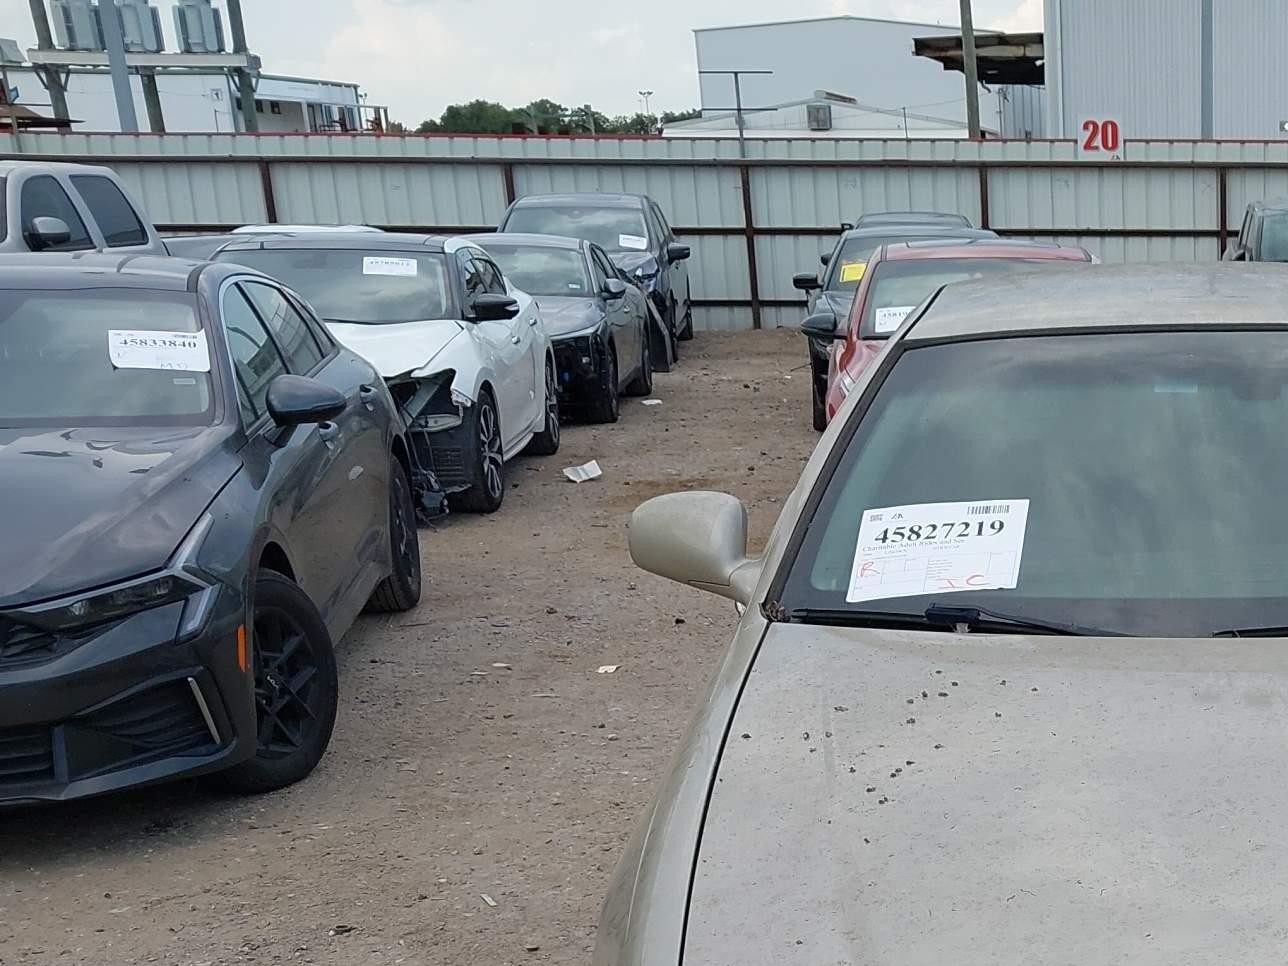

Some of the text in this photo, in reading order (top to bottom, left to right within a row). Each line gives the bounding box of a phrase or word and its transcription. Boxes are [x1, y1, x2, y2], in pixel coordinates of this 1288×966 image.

[1082, 119, 1119, 151] 20
[119, 338, 197, 349] 45833840
[874, 519, 1005, 544] 45827219
